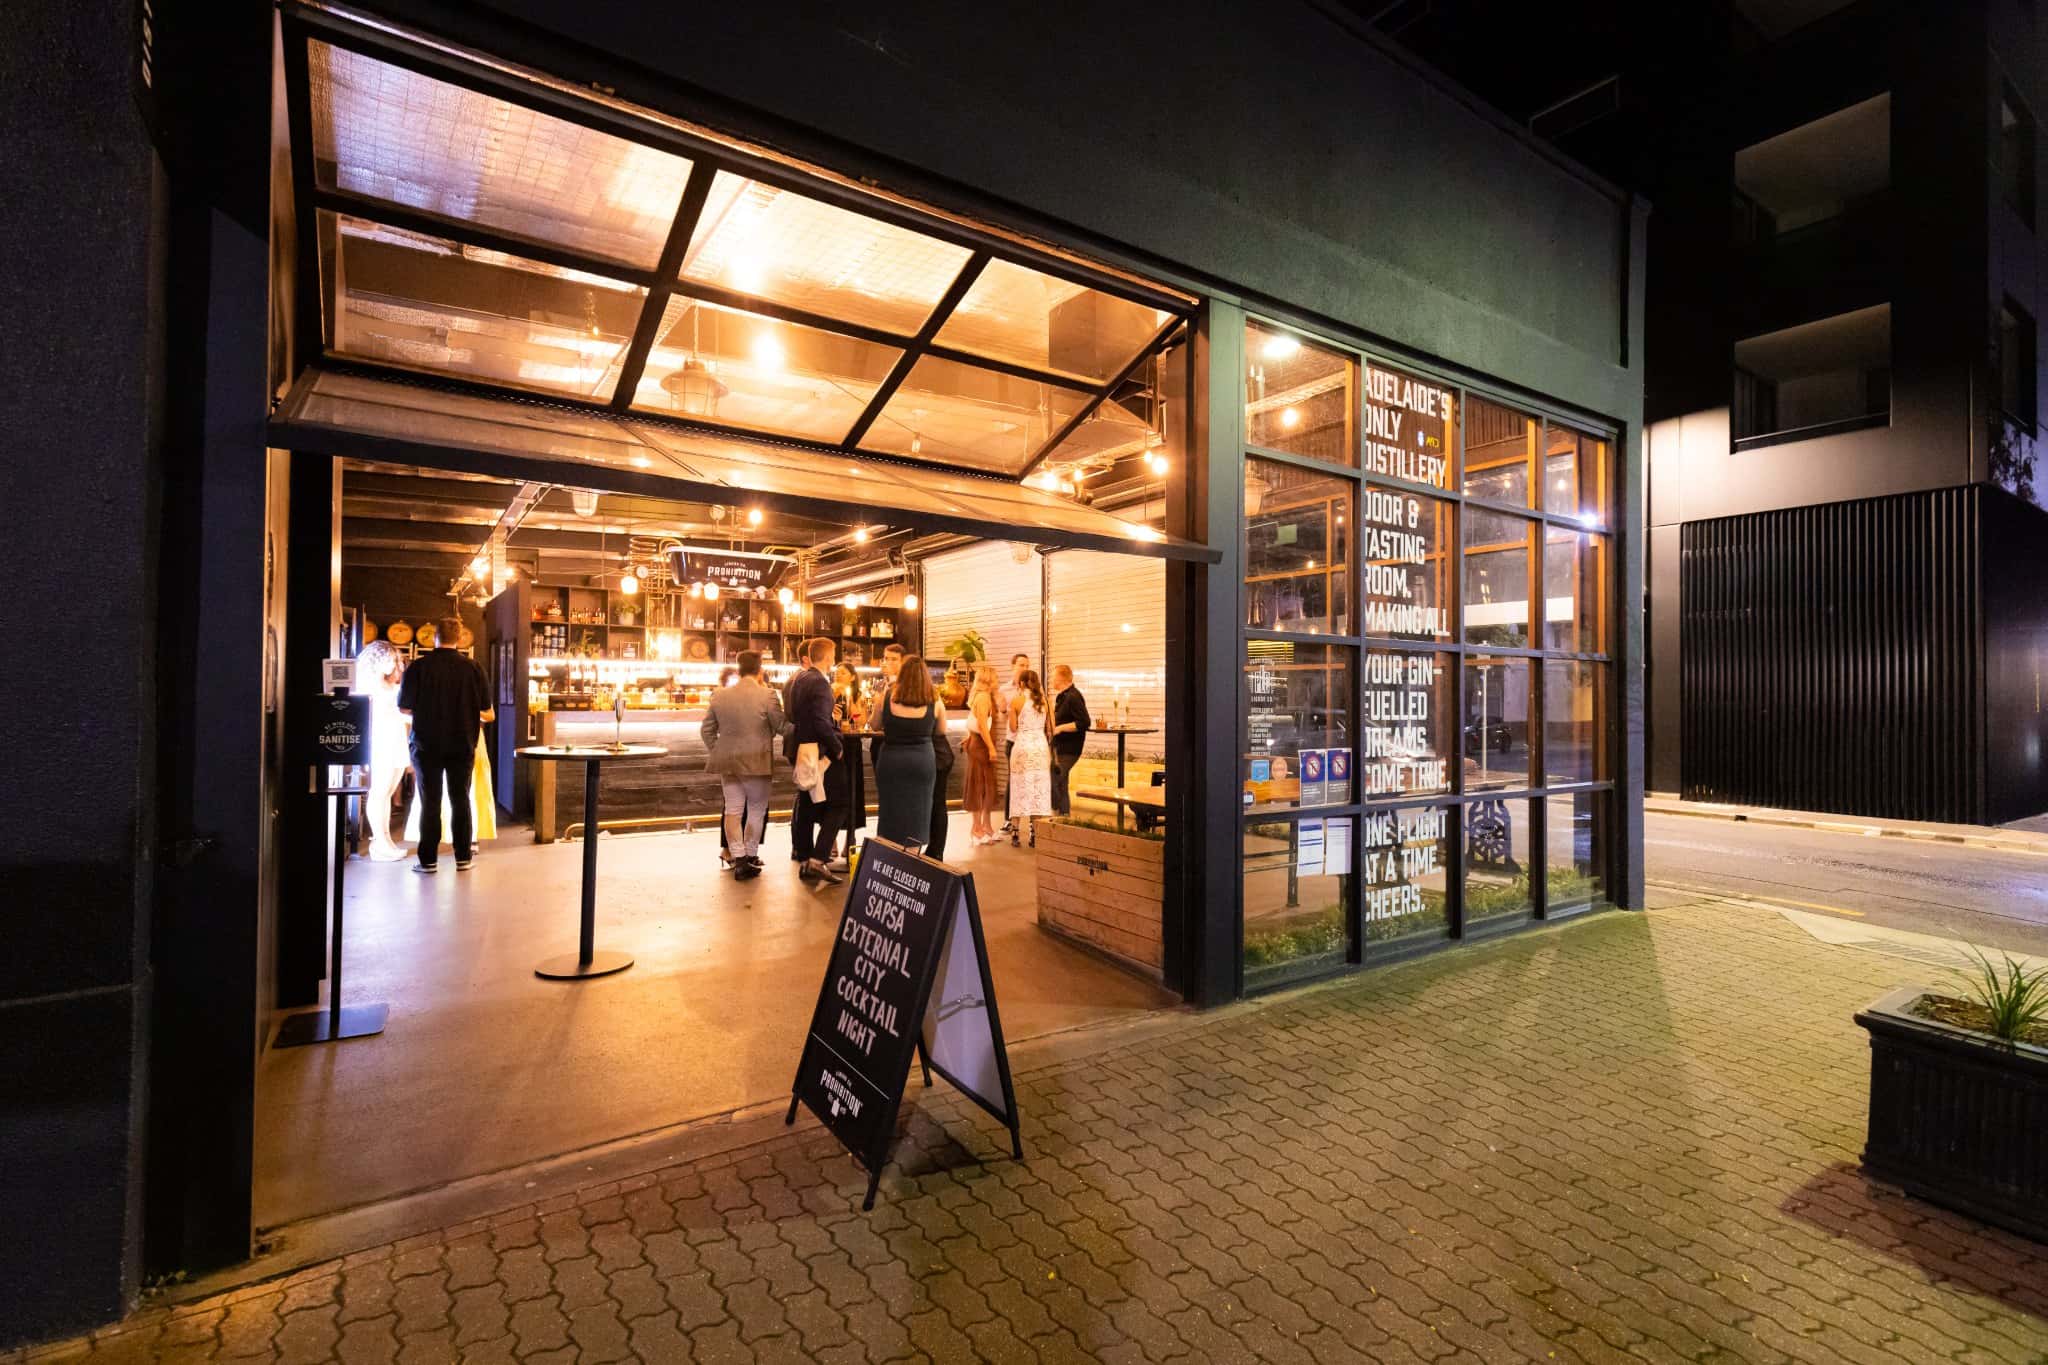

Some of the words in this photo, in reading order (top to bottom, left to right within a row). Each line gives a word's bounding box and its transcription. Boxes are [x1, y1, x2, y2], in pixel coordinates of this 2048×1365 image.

[1366, 367, 1452, 420] ADELAIDE'S
[1408, 499, 1418, 528] &
[319, 734, 361, 744] SANITISE
[893, 868, 918, 889] CLOSED
[916, 878, 931, 895] FOR
[1385, 851, 1397, 882] A
[865, 895, 905, 935] SAPSA
[871, 880, 895, 901] PRIVATE
[894, 891, 926, 917] FUNCTION
[842, 918, 911, 978] EXTERNAL
[854, 955, 886, 993] CITY
[837, 975, 899, 1038] COCKTAIL
[836, 1009, 877, 1057] NIGHT
[820, 1069, 861, 1118] PROHIBITION
